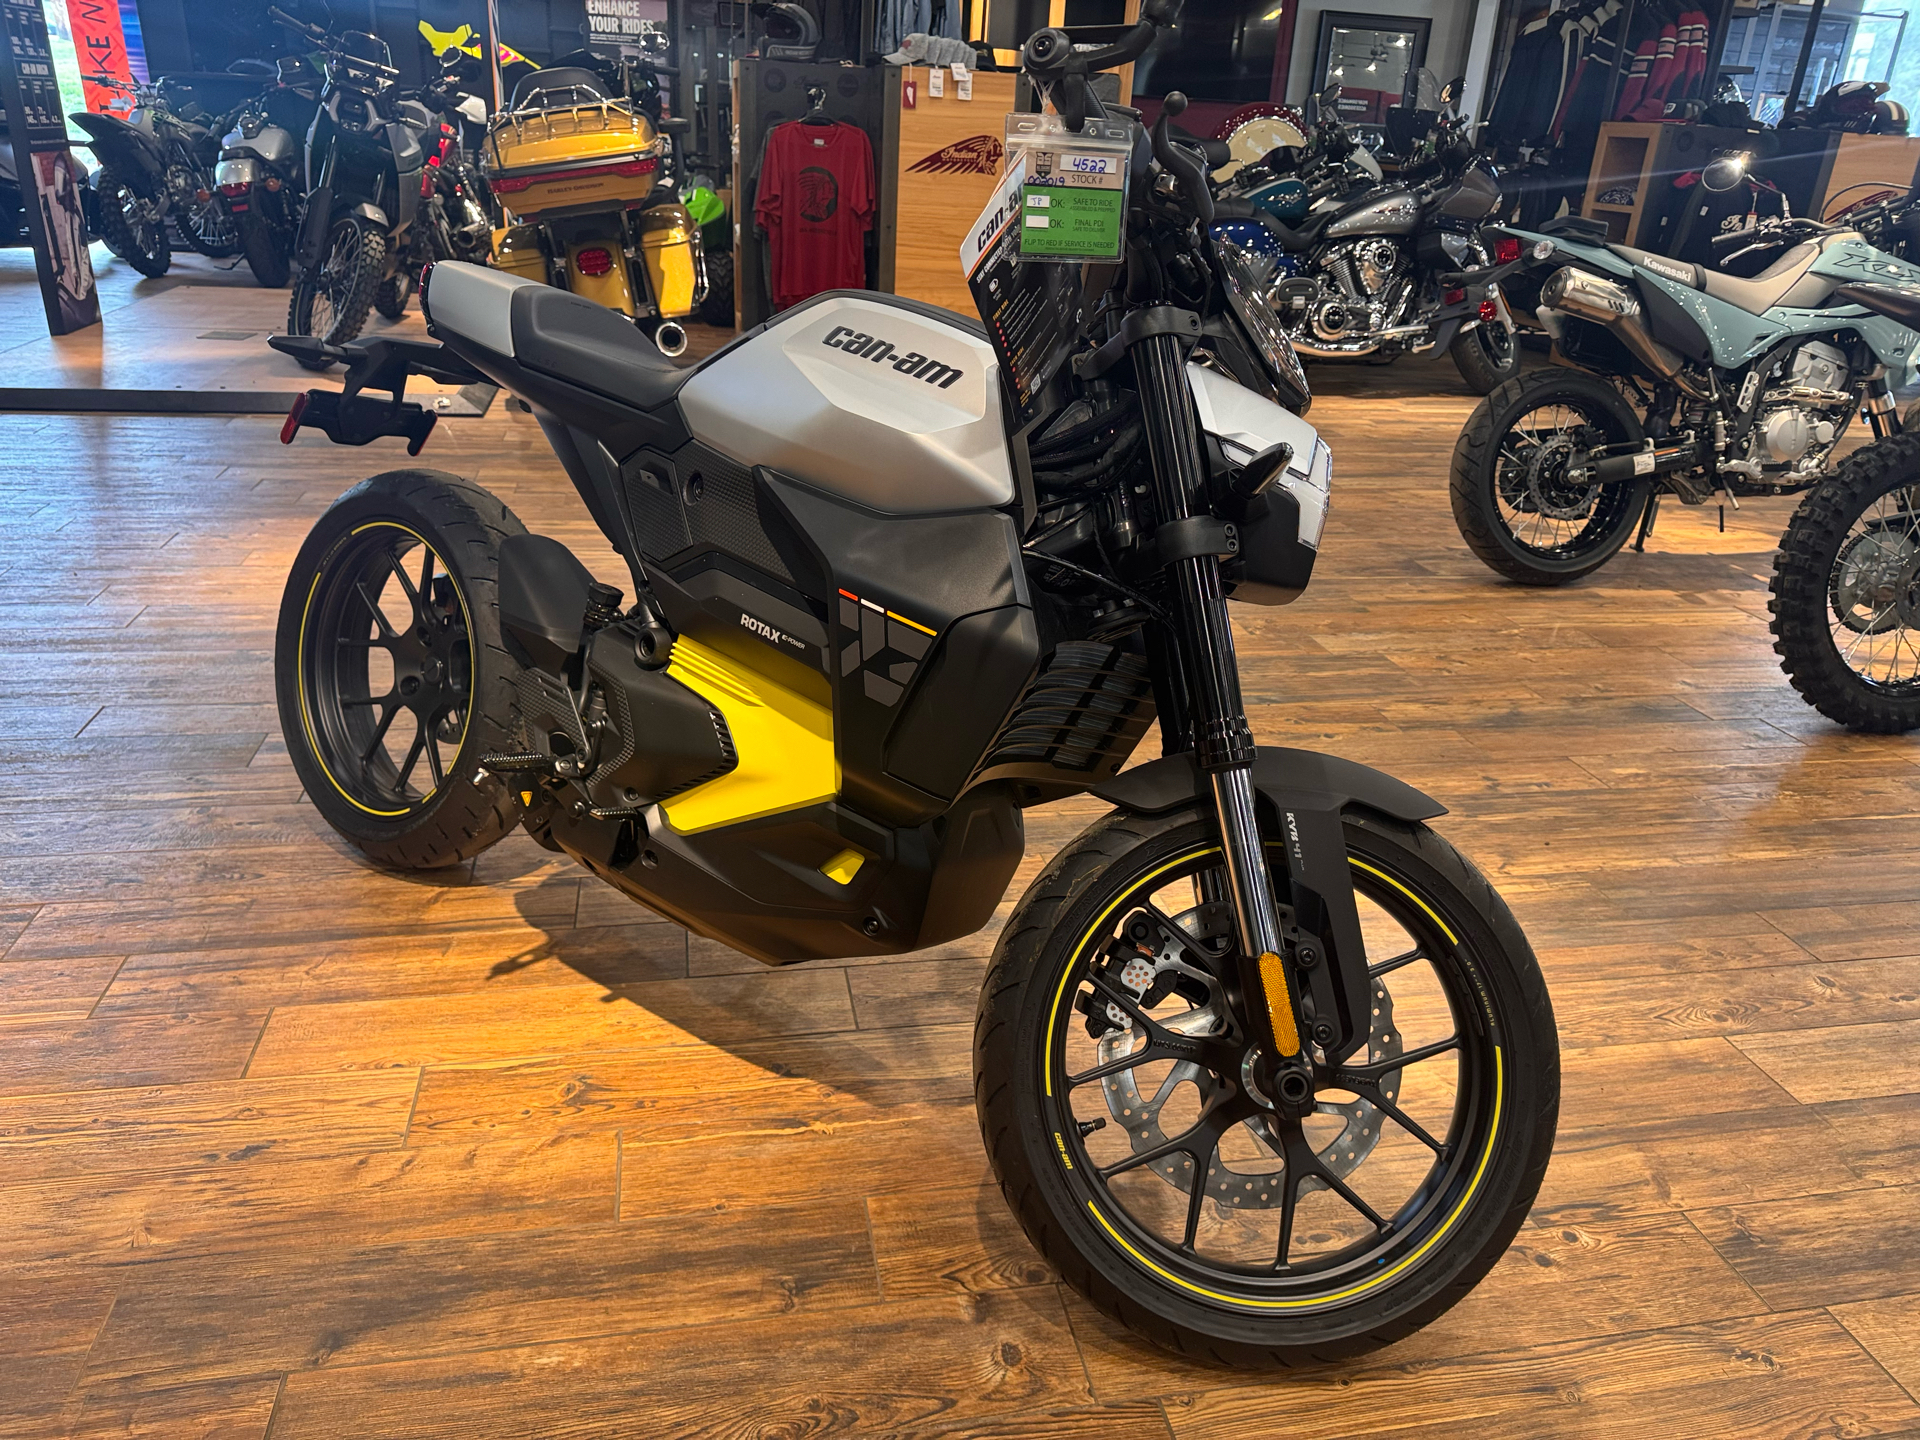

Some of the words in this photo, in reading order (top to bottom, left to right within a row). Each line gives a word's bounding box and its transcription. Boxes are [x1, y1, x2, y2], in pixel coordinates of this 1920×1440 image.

[588, 0, 640, 17] ENHANCE
[588, 15, 619, 33] YOUR
[622, 18, 654, 35] RIDES
[940, 146, 978, 159] Indian
[1073, 157, 1107, 174] 4522
[1072, 174, 1097, 184] STOCK
[1050, 198, 1066, 209] OK:
[1073, 197, 1089, 206] SAFE
[1089, 198, 1098, 206] TO
[1098, 199, 1112, 207] RIDE
[1049, 219, 1064, 229] OK:
[1074, 219, 1092, 227] FINAL
[1024, 238, 1036, 246] FLIP
[1046, 239, 1058, 247] RED
[1064, 240, 1086, 248] SERVICE
[1093, 241, 1115, 249] NEEDED
[1643, 256, 1691, 282] Kawasaki
[821, 325, 964, 389] can-am
[740, 613, 781, 644] ROTAX
[1286, 812, 1299, 842] KYB
[1054, 1132, 1074, 1170] can-am
